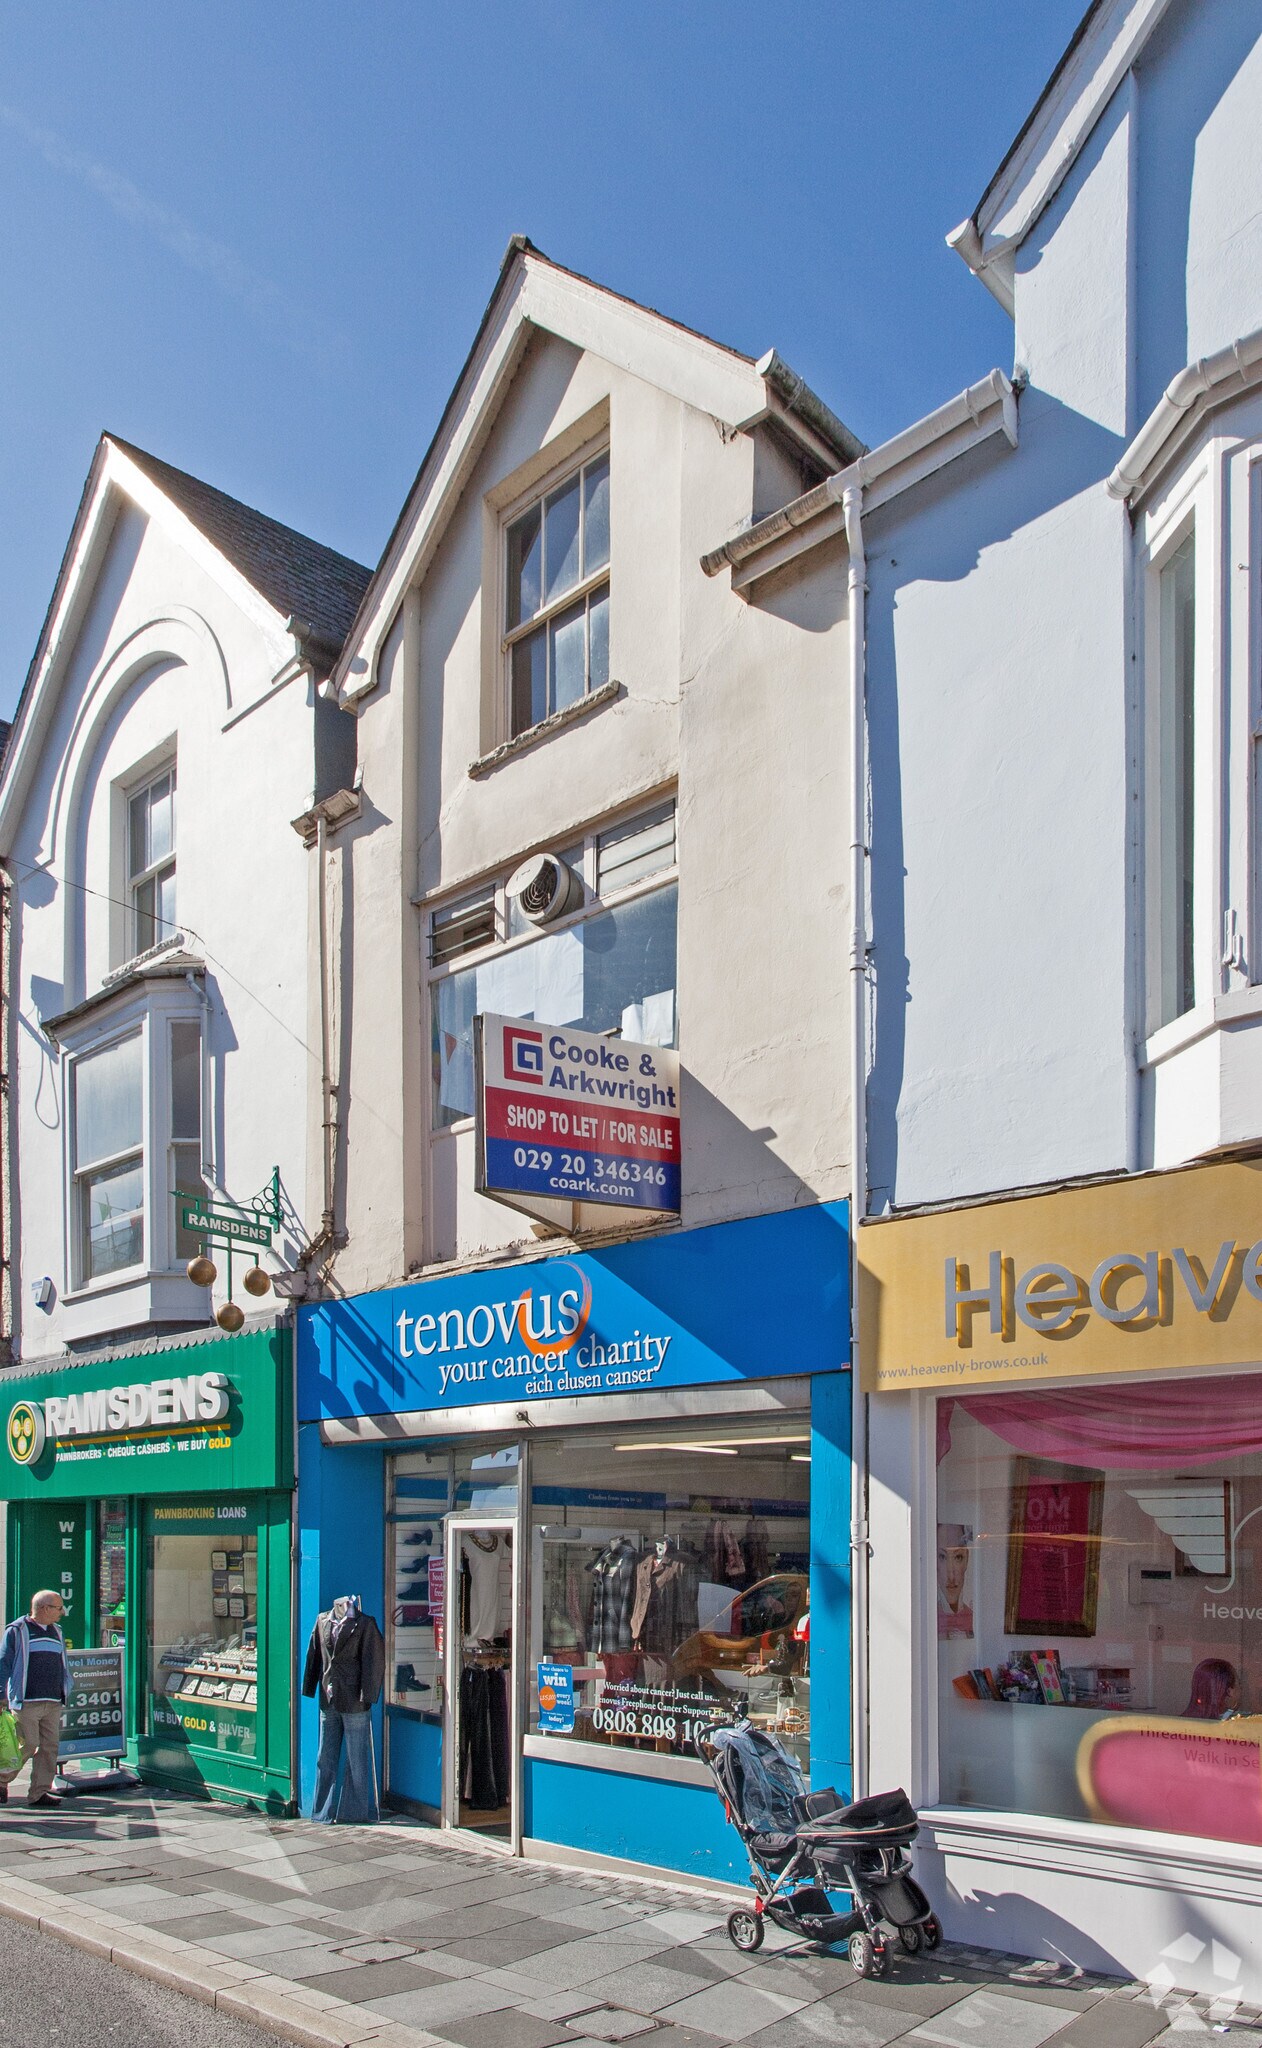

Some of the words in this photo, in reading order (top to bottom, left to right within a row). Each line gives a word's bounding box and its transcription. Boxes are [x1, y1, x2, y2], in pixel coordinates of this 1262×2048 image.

[549, 1036, 629, 1072] Cooke
[638, 1053, 657, 1077] &
[549, 1065, 676, 1108] Arkwright
[507, 1104, 546, 1131] SHOP
[550, 1112, 569, 1134] TO
[573, 1116, 598, 1139] LET
[610, 1121, 636, 1144] FOR
[640, 1125, 673, 1150] SALE
[514, 1148, 552, 1171] 029
[561, 1154, 585, 1175] 20
[593, 1159, 666, 1186] 346346
[550, 1177, 635, 1197] coark.com
[188, 1213, 268, 1241] RAMSDENS
[396, 1289, 580, 1358] tenovus
[439, 1360, 488, 1394] your
[491, 1349, 569, 1378] cancer
[576, 1330, 672, 1371] charity
[877, 1352, 1049, 1379] www.heavenly-brows.co.uk
[525, 1376, 553, 1395] eich
[557, 1372, 602, 1392] elusen
[606, 1367, 654, 1386] canser
[45, 1372, 229, 1437] RAMSDENS
[56, 1449, 102, 1462] PAWNBROKERS
[107, 1445, 136, 1458] CHEQUE
[137, 1442, 170, 1455] CASHERS
[177, 1440, 189, 1451] WE
[191, 1439, 207, 1450] BUY
[208, 1437, 231, 1449] GOLD
[154, 1507, 215, 1519] PAWNBROKING
[217, 1506, 247, 1518] LOANS
[59, 1521, 75, 1550] WE
[68, 1659, 84, 1667] vel
[87, 1658, 119, 1666] Money
[73, 1670, 118, 1678] Commission
[542, 1673, 568, 1687] win
[603, 1682, 629, 1692] Worried
[630, 1684, 650, 1694] about
[650, 1688, 675, 1697] cancer?
[675, 1689, 690, 1699] Just
[691, 1691, 704, 1700] call
[62, 1691, 120, 1708] .3401
[621, 1697, 657, 1710] Freephone
[657, 1702, 682, 1713] Cancer
[682, 1705, 712, 1718] Support
[60, 1710, 122, 1728] 1.4850
[153, 1710, 165, 1722] WE
[166, 1713, 183, 1726] BUY
[184, 1716, 207, 1731] GOLD
[209, 1720, 216, 1732] &
[218, 1722, 250, 1738] SILVER
[592, 1708, 637, 1734] 0808
[641, 1714, 676, 1740] 808
[1138, 1727, 1211, 1746] Threading
[1184, 1749, 1219, 1764] Walk
[1224, 1753, 1237, 1766] in
